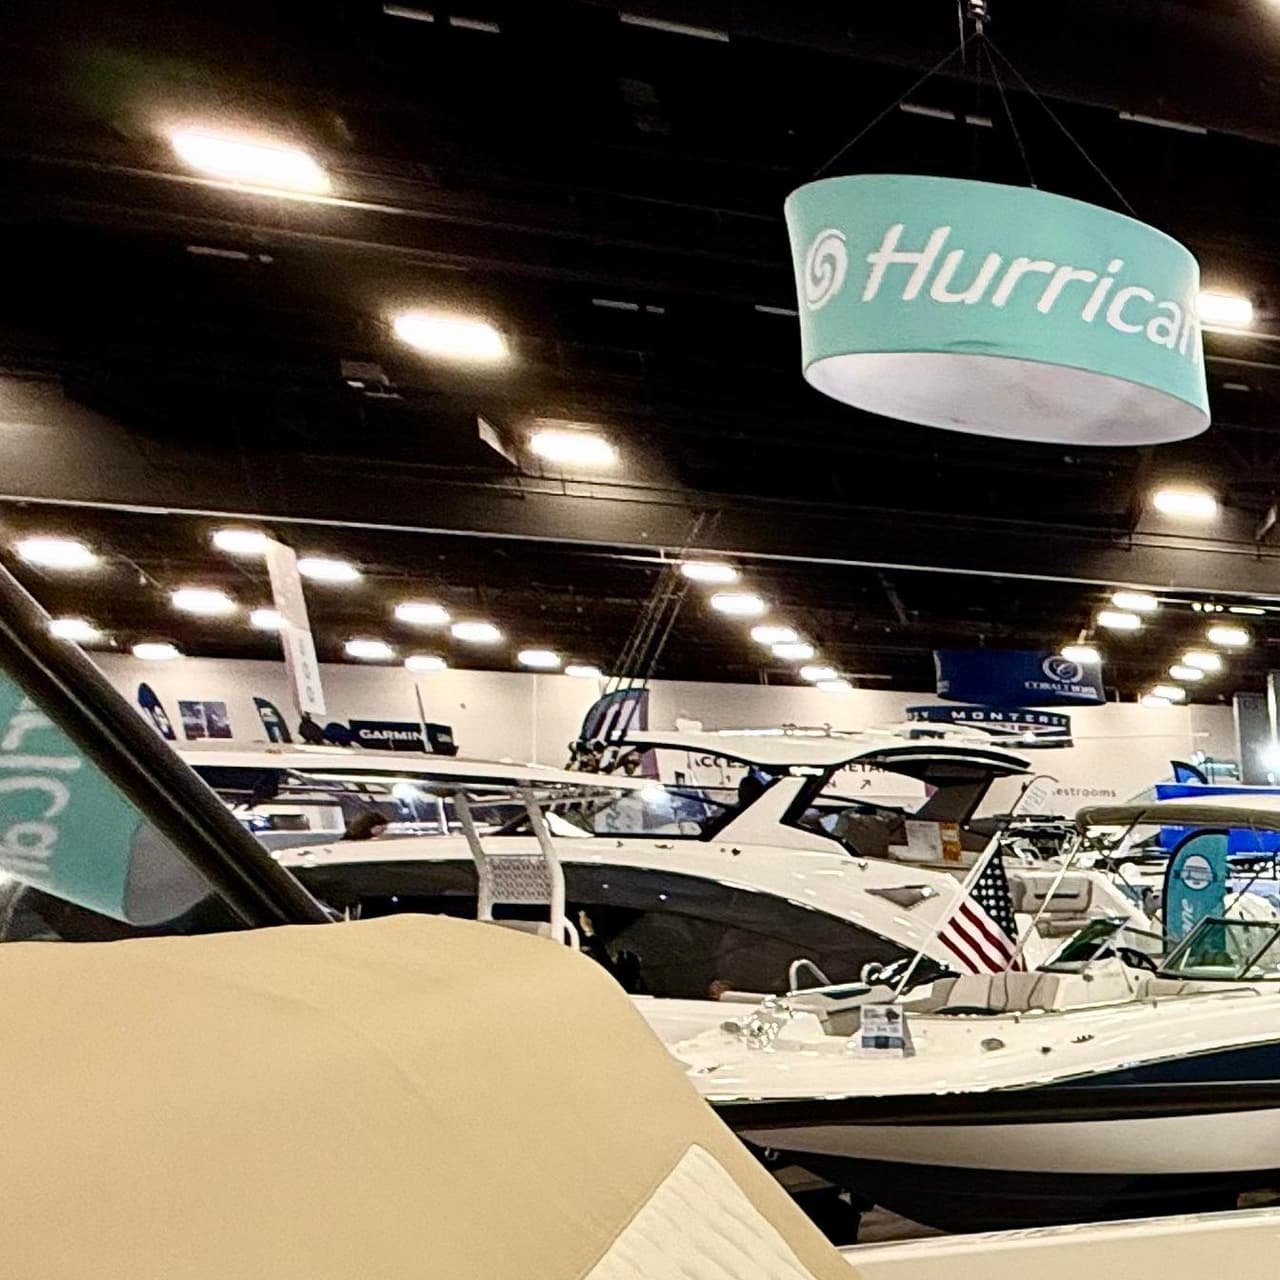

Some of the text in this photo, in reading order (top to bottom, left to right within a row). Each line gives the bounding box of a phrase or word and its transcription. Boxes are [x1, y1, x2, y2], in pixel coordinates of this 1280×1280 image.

[861, 222, 1199, 365] Hurrican
[950, 710, 1068, 726] MONTEREY
[359, 728, 425, 742] GARMIN
